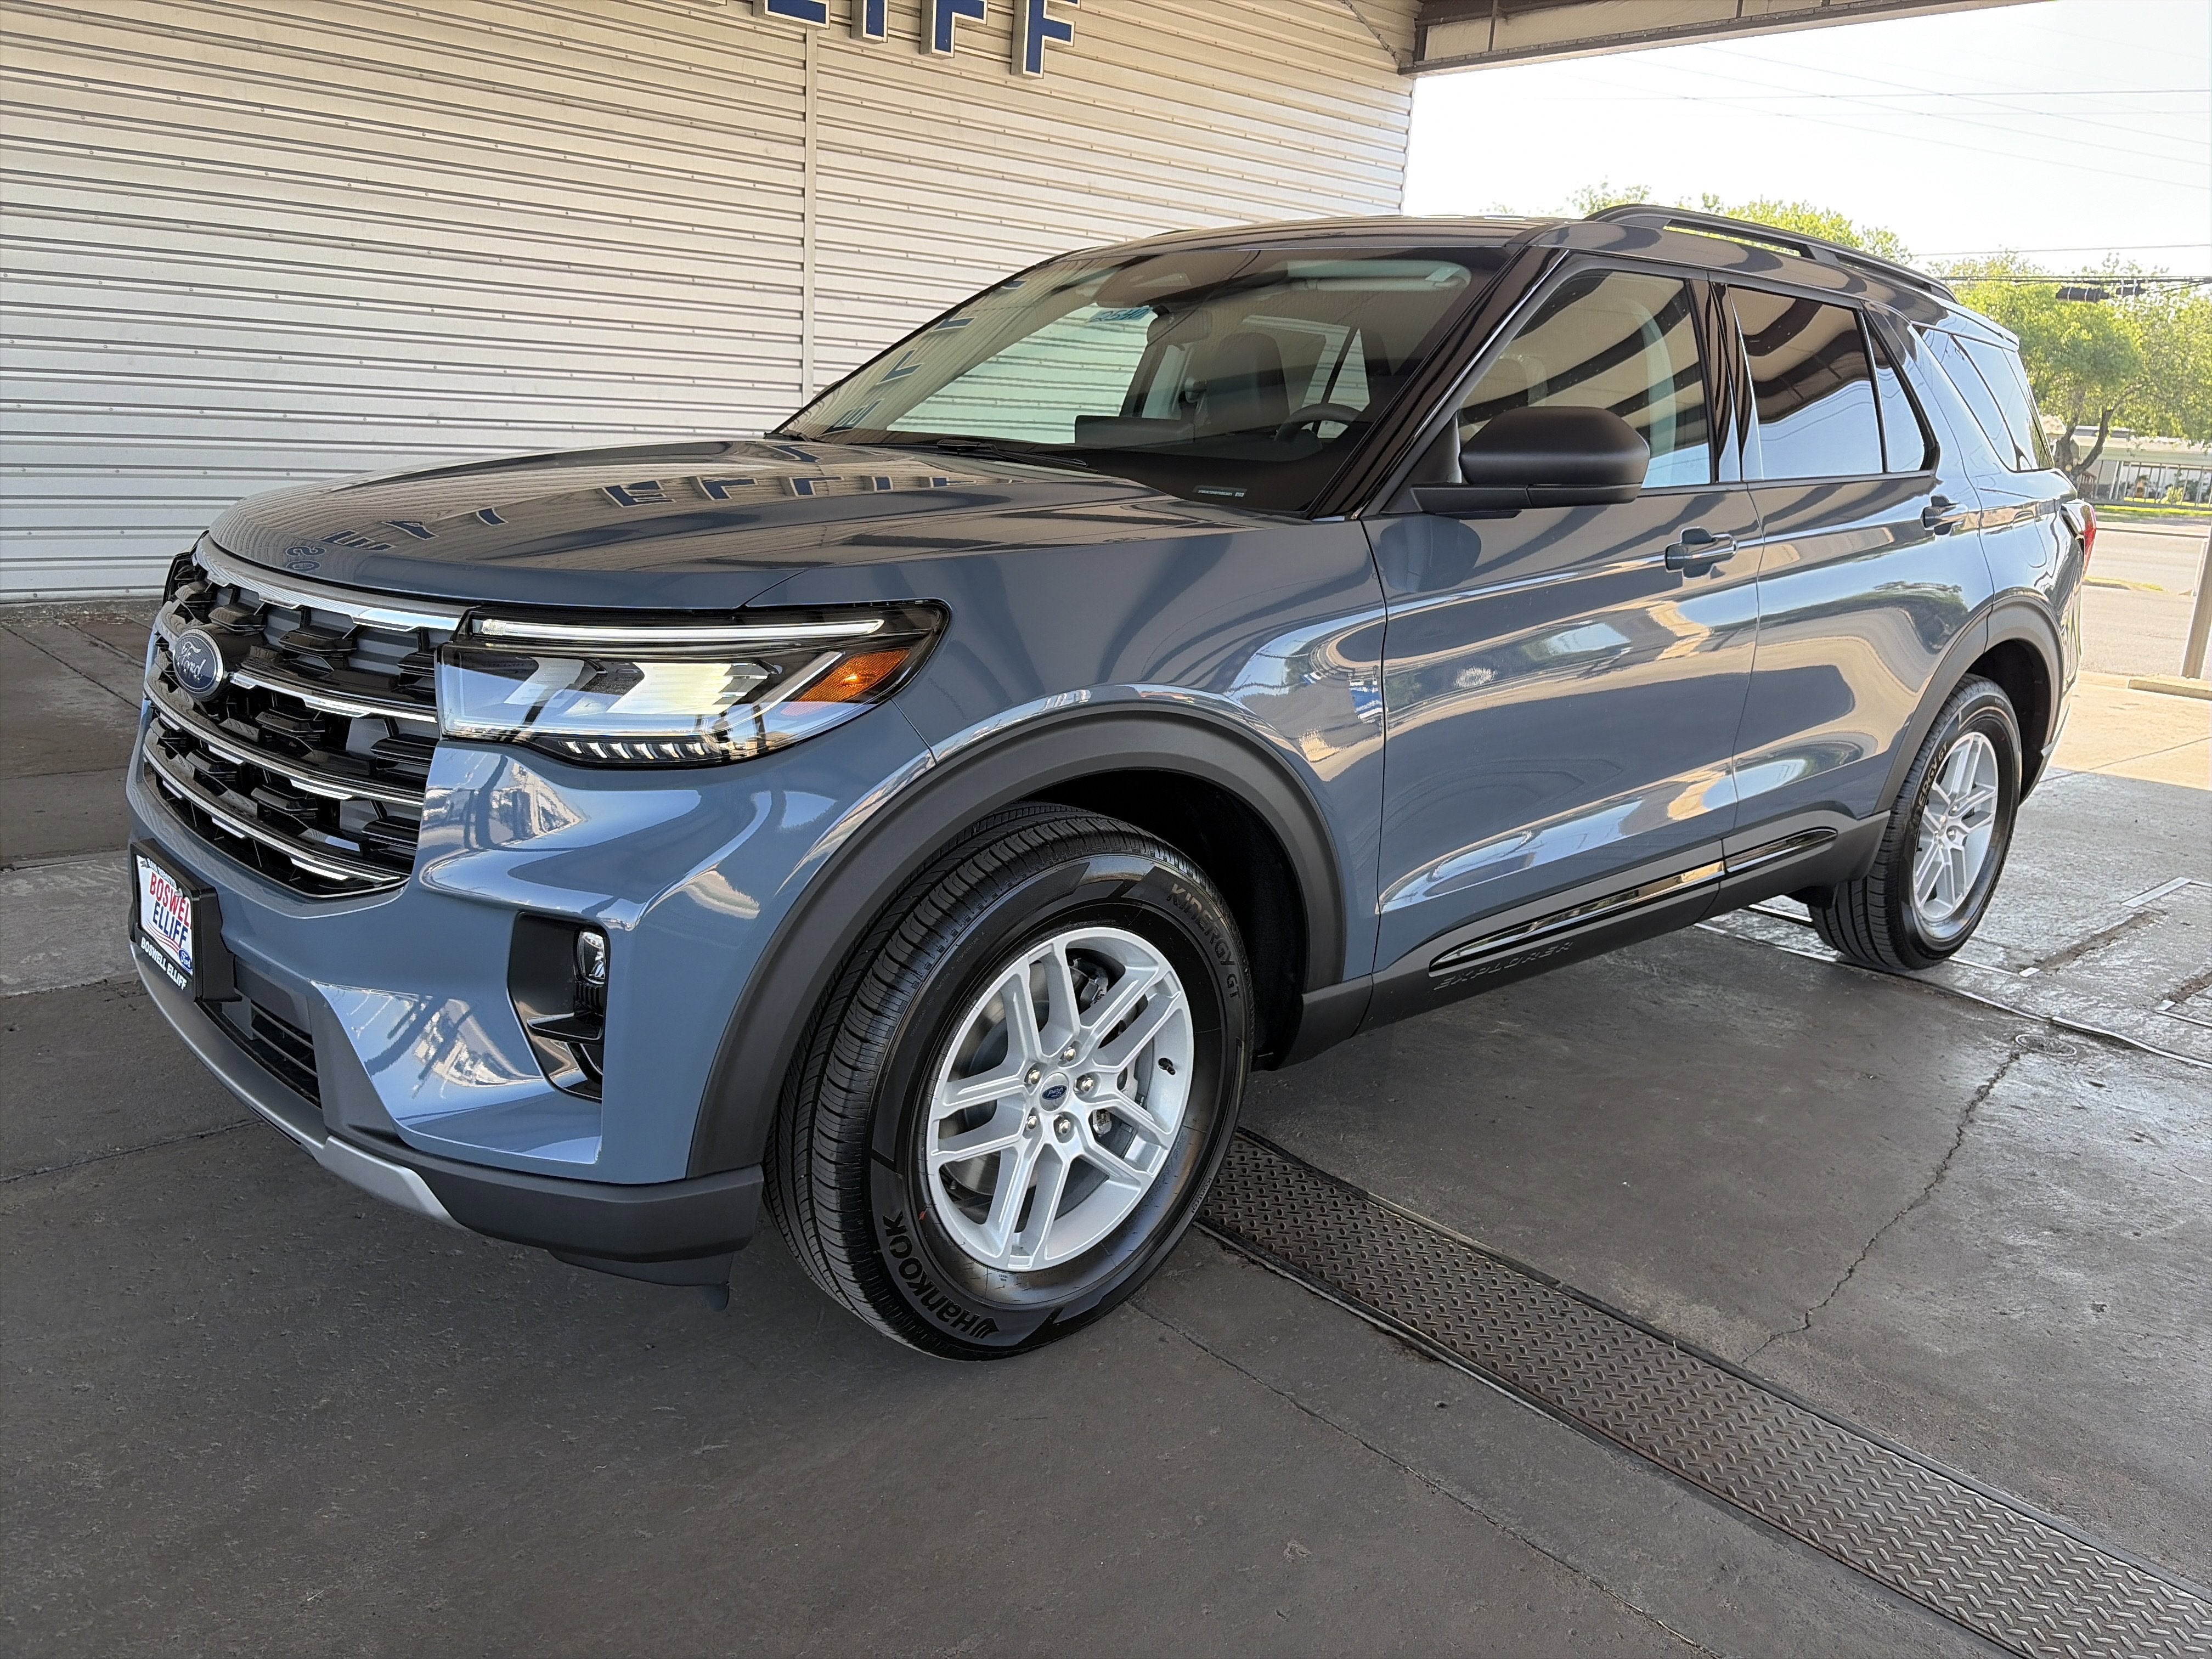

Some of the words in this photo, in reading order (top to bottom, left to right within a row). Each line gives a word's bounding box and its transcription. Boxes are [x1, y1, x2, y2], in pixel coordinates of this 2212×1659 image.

[177, 641, 207, 680] Ford
[153, 900, 189, 949] ELLIFF
[1166, 883, 1235, 966] KINERGY
[1226, 973, 1240, 998] GT
[140, 936, 166, 972] BOSWELL
[166, 962, 187, 990] ELLIFF
[1433, 941, 1574, 991] EXPLORER
[1046, 1086, 1064, 1098] Ford
